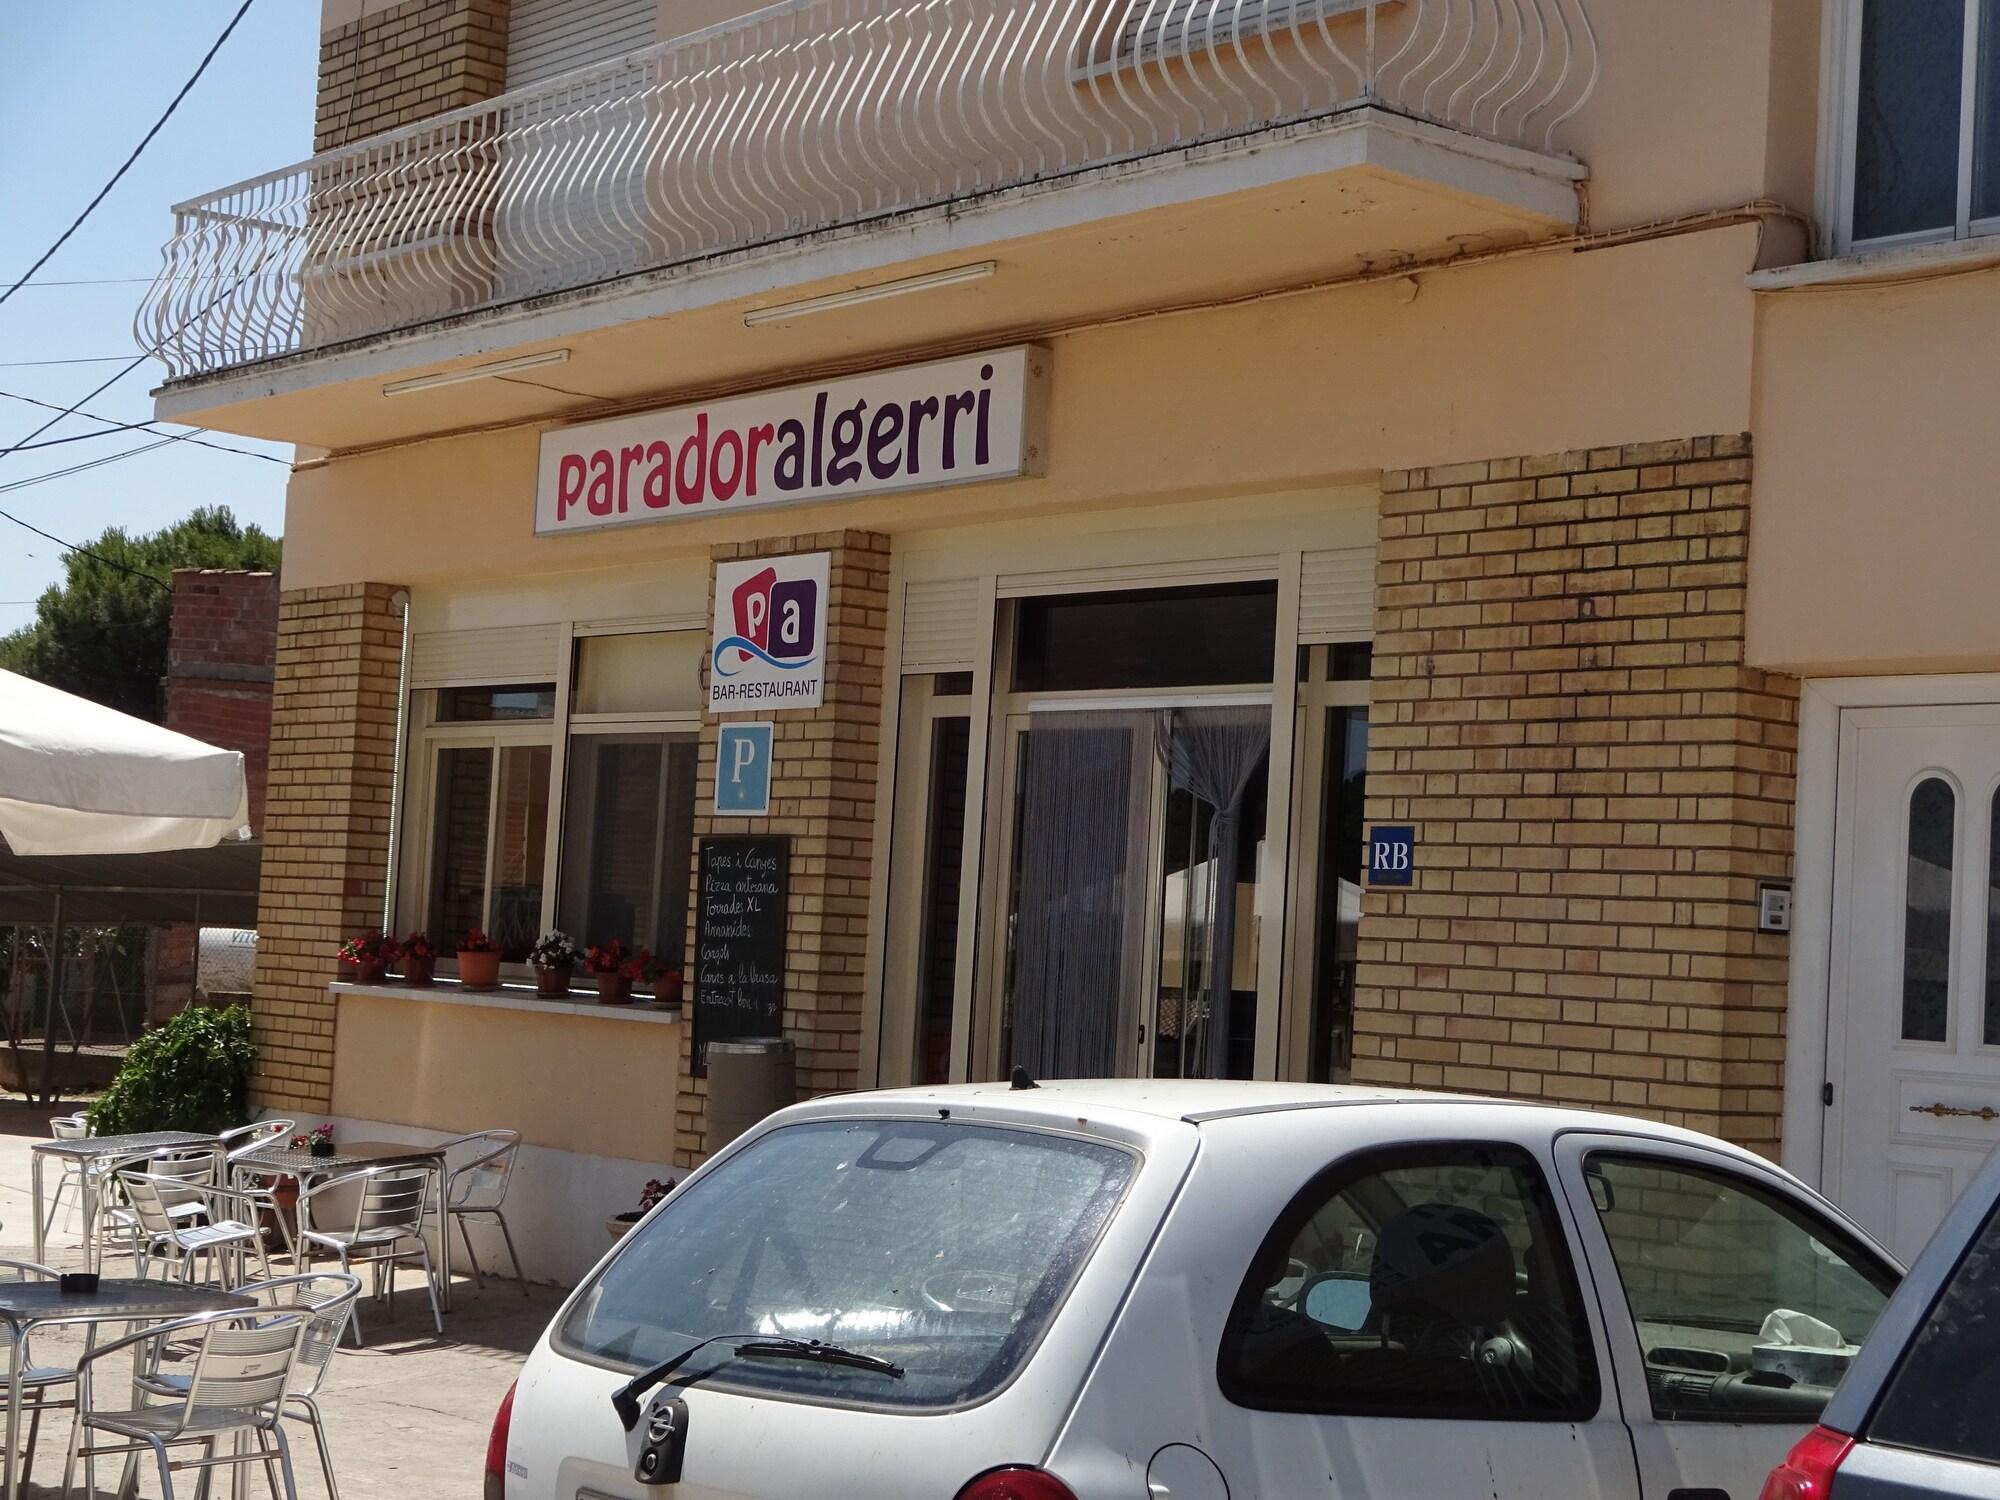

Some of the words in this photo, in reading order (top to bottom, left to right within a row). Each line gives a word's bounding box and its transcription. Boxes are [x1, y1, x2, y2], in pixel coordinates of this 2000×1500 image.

[712, 679, 818, 700] BAR-RESTAURANT
[731, 738, 755, 783] P
[705, 846, 731, 874] Tapes
[735, 852, 742, 868] i
[745, 848, 776, 879] Canyes
[1373, 842, 1408, 869] RB
[706, 874, 731, 892] Pizza
[735, 875, 779, 893] artesana
[704, 894, 743, 917] Torrades
[747, 896, 761, 912] XL
[738, 962, 748, 983] la
[750, 961, 778, 984] brasa
